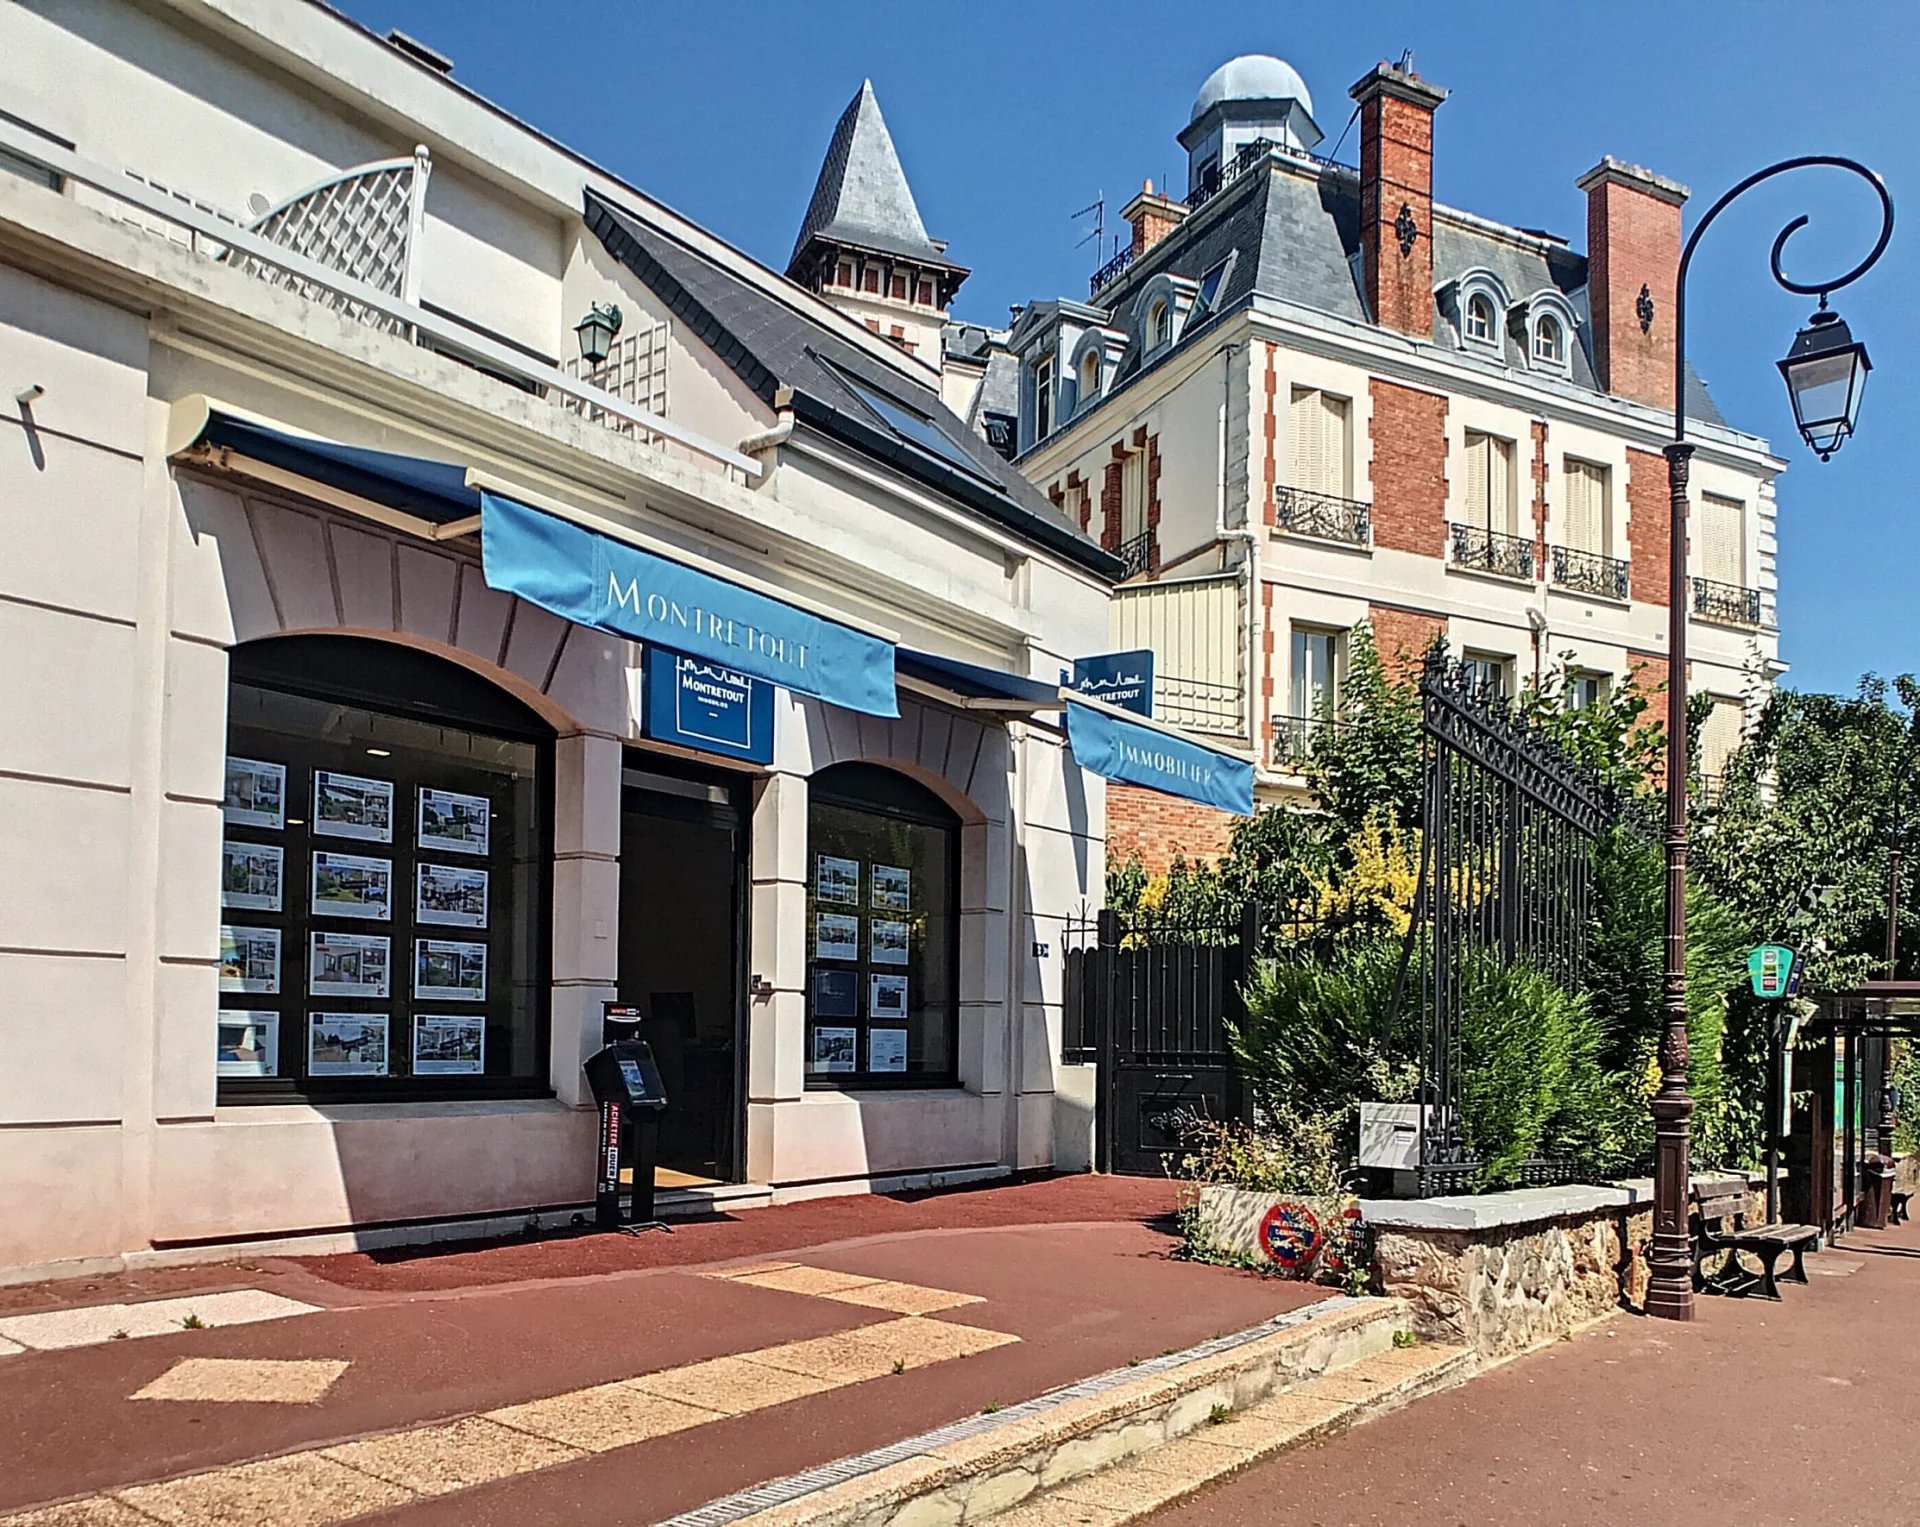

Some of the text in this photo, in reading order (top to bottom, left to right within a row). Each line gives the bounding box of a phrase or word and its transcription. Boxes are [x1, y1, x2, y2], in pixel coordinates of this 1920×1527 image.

[607, 571, 808, 668] MONTRETOUT
[682, 675, 744, 703] MONTRETOUT
[1119, 740, 1211, 785] IMMOBILIER
